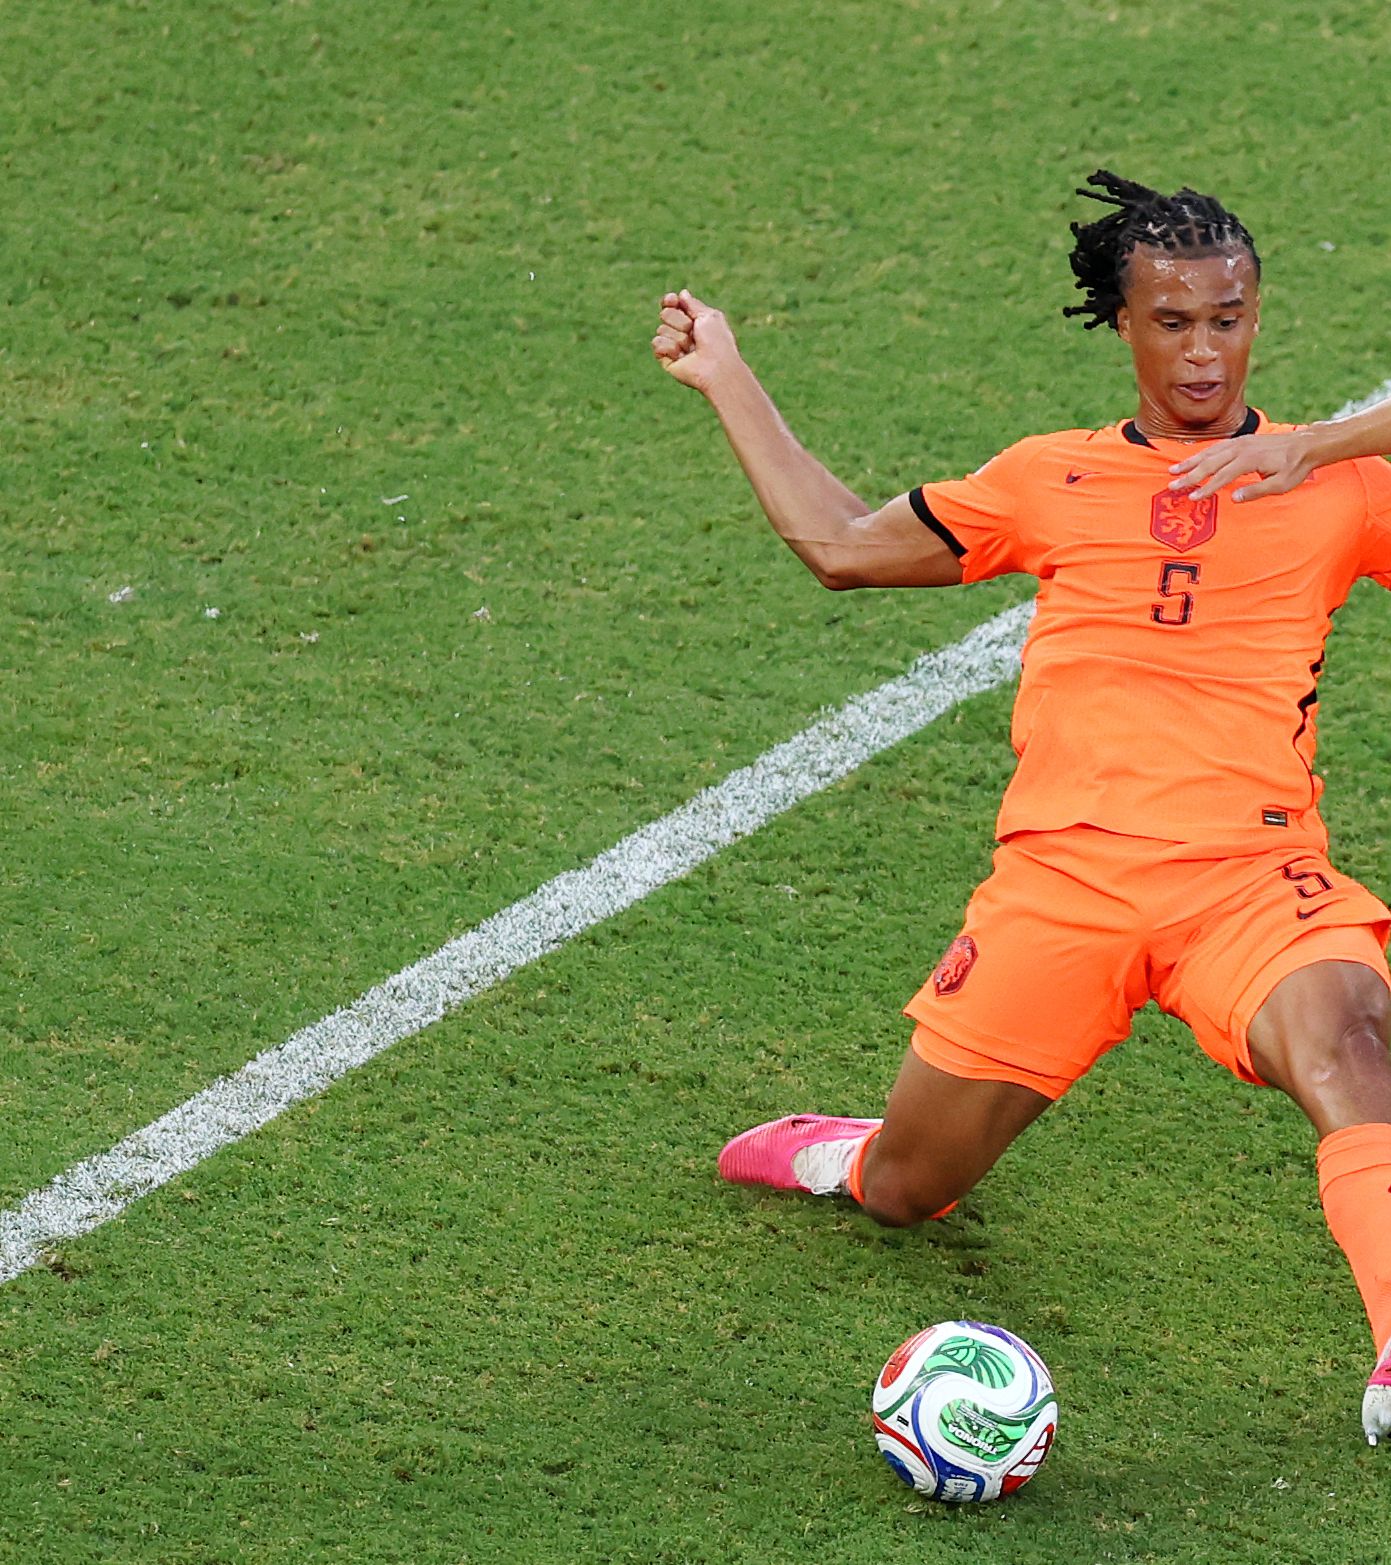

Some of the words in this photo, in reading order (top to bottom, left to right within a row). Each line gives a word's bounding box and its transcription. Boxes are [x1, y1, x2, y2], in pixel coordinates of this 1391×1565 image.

[1151, 560, 1201, 626] 5
[1281, 864, 1334, 899] 5
[948, 1422, 999, 1455] TRIONDA
